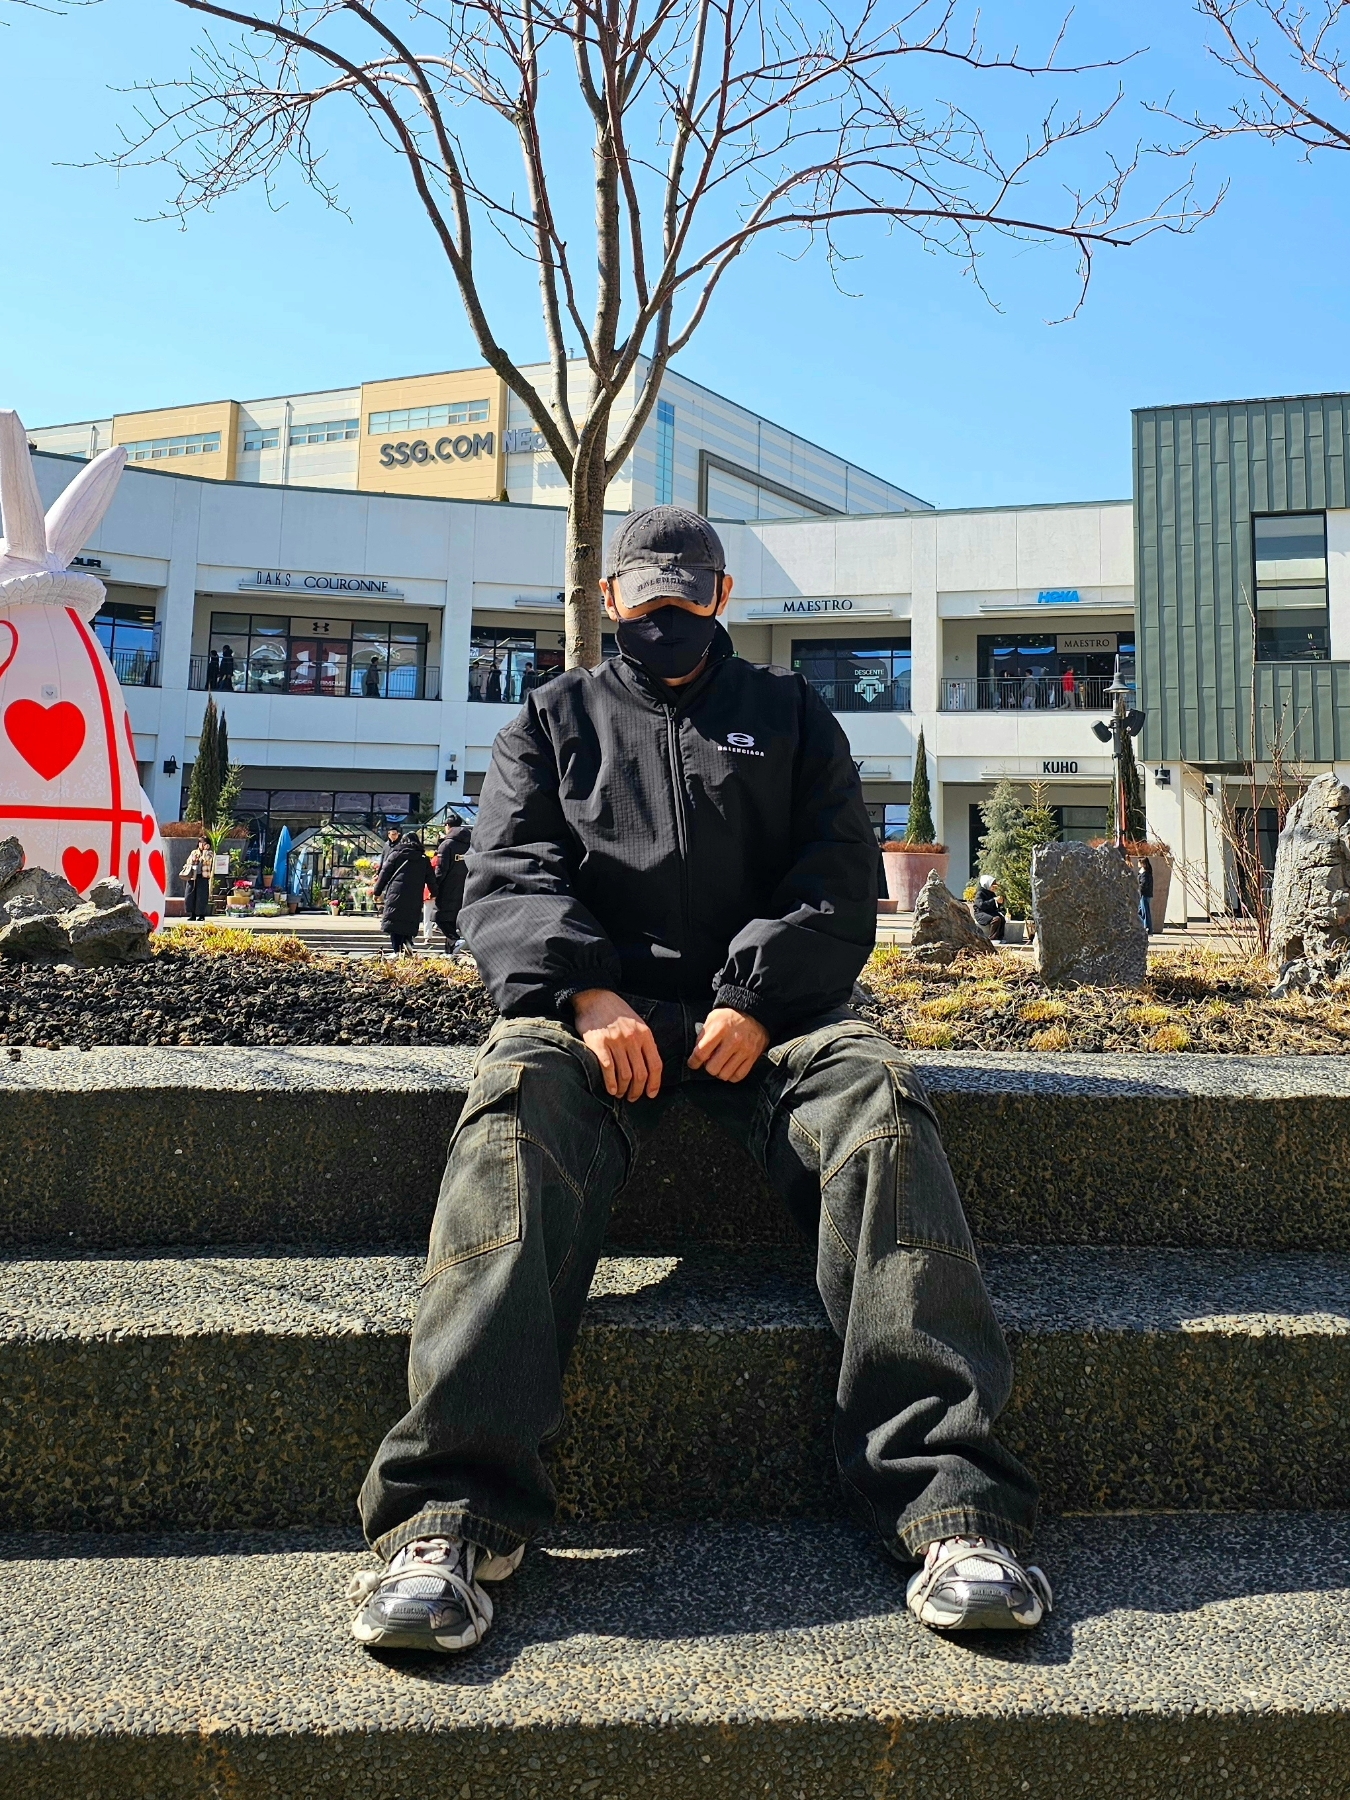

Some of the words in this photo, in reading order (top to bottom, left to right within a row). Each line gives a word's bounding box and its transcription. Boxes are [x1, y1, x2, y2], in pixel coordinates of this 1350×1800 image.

[379, 431, 494, 466] SSG.COM
[70, 556, 102, 568] OUR
[256, 570, 291, 587] DAKS
[303, 575, 389, 593] COURONNE
[1037, 590, 1080, 603] HOKA
[783, 599, 853, 612] MAESTRO
[1063, 638, 1110, 648] MAESTRO
[717, 745, 765, 757] BALENCIAGA
[1043, 761, 1078, 774] KUHO
